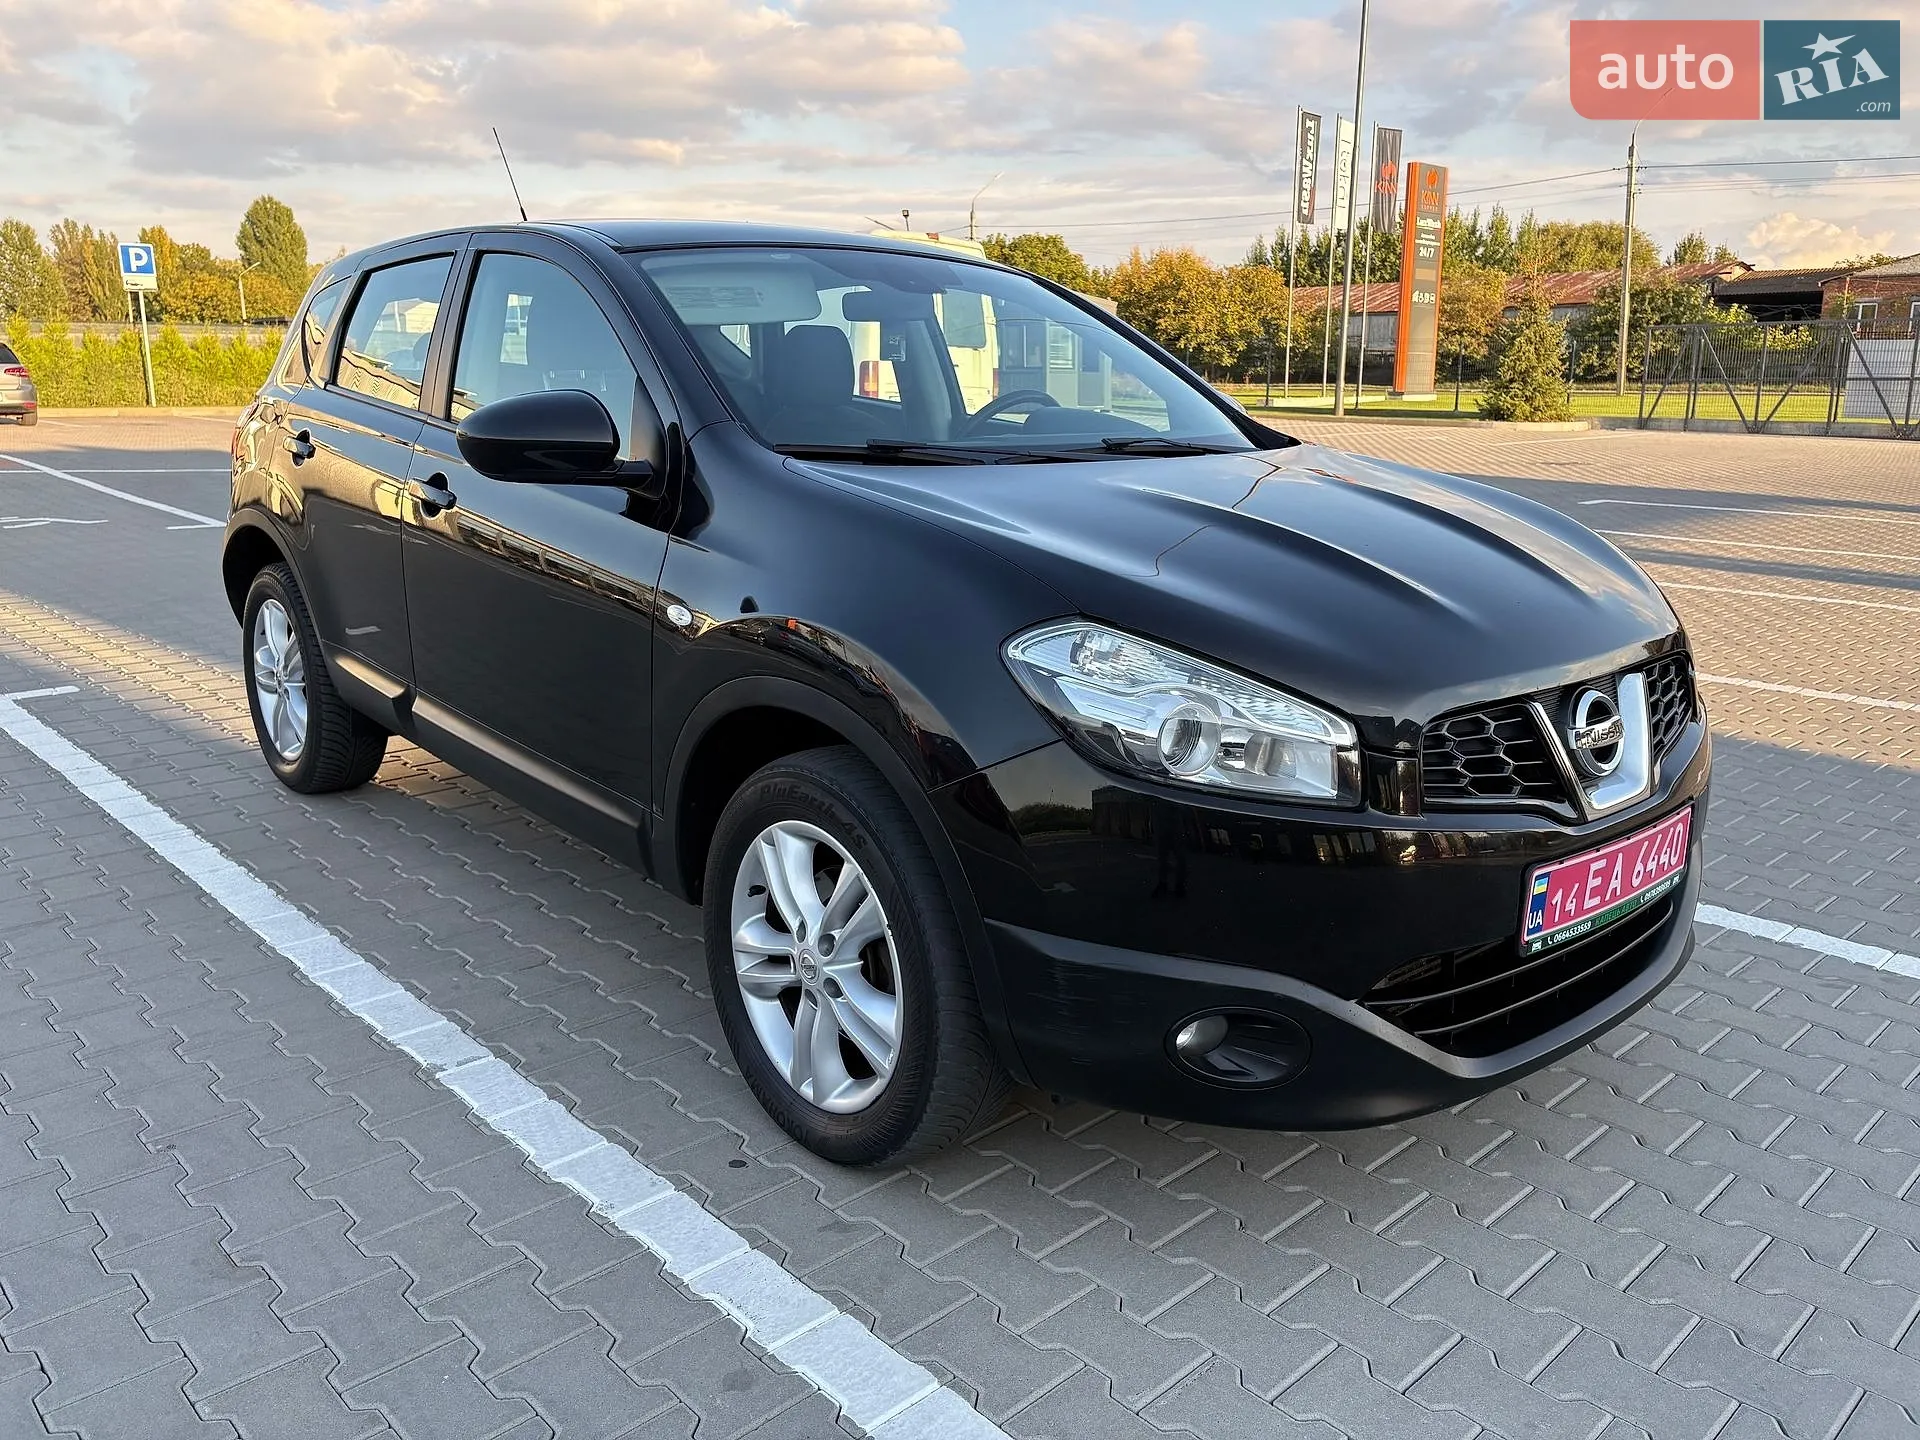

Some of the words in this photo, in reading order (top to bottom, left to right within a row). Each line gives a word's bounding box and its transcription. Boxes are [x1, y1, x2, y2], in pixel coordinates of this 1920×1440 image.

[128, 247, 148, 272] P
[1550, 883, 1580, 922] 14
[1583, 852, 1623, 910] EA
[1631, 822, 1683, 888] 6440
[1529, 913, 1543, 929] UA
